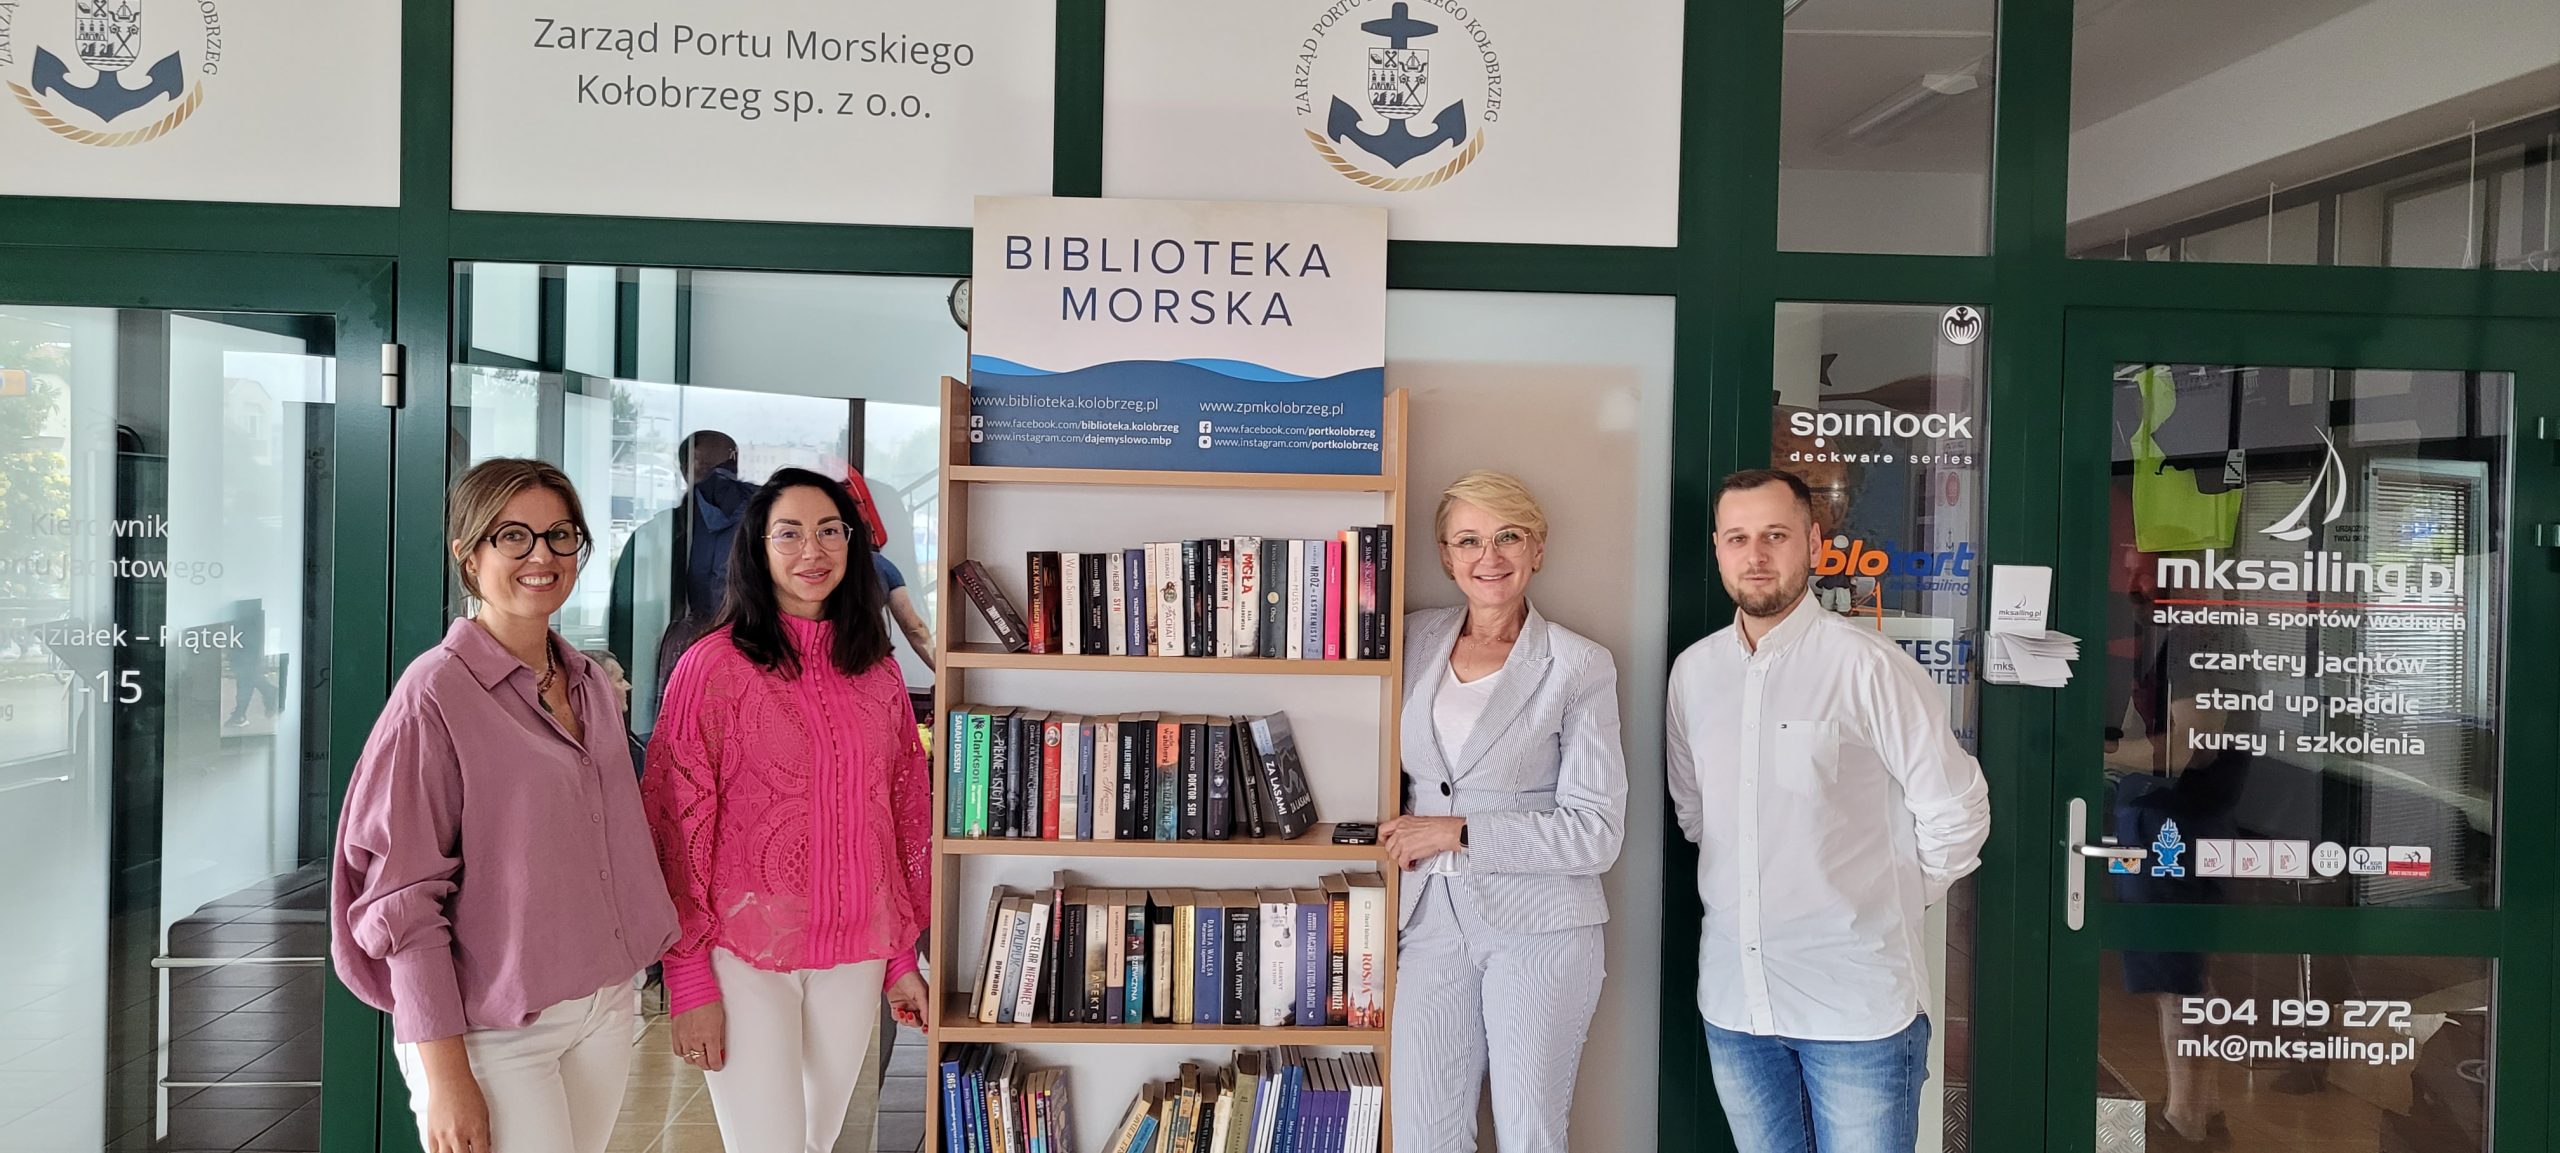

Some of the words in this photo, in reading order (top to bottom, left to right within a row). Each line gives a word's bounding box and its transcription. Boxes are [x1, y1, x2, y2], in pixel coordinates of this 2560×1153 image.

[199, 0, 222, 76] OBRZEG
[533, 18, 659, 60] Zarząd
[672, 24, 772, 58] Portu
[786, 30, 975, 74] Morskiego
[1294, 38, 1318, 116] ZARZĄD
[1465, 19, 1502, 123] KOŁOBRZEG
[577, 74, 761, 120] Kołobrzeg
[773, 89, 824, 122] sp.
[837, 92, 854, 115] z
[866, 92, 931, 118] o.o.
[1005, 235, 1332, 279] BIBLIOTEKA
[1061, 287, 1294, 327] MORSKA
[971, 394, 1159, 413] www.biblioteka.kolobrzeg.pl
[1199, 399, 1344, 417] www.zpmkolobrzeg.pl
[986, 416, 1180, 433] www.facebook.com/biblioteka.kolobrzeg
[1214, 423, 1376, 439] www.facebook.com/portkolobrzeg
[1790, 410, 1973, 448] spinlock
[985, 431, 1172, 447] www.instagram.com/dajemyslowo.mbp
[1214, 437, 1379, 452] www.instagram.com/portkolobrzeg
[1790, 452, 1893, 464] deckware
[1910, 453, 1973, 465] series
[31, 512, 169, 538] Kierownik
[1241, 553, 1255, 594] MGŁA
[1310, 565, 1319, 587] MRÓZ
[2157, 548, 2465, 604] mksailing.pl
[1291, 585, 1299, 612] MUSSO
[2153, 606, 2259, 626] akademia
[2268, 610, 2360, 631] sportów
[2369, 614, 2466, 633] wodnych
[160, 626, 244, 654] Piątek
[1895, 640, 1971, 666] TEST
[2189, 649, 2306, 677] czartery
[2315, 651, 2427, 677] jachtów
[1930, 669, 1970, 685] TER
[2195, 689, 2274, 711] stand
[2286, 694, 2319, 717] up
[2330, 695, 2420, 718] paddle
[2188, 728, 2267, 755] kursy
[2279, 730, 2285, 751] i
[2296, 733, 2425, 755] szkolenia
[953, 744, 962, 772] DESSEN
[972, 731, 983, 784] Clarkson
[1265, 761, 1276, 775] ZA
[1124, 763, 1132, 780] HORST
[1188, 774, 1196, 800] DOKTOR
[1269, 775, 1288, 816] LASAMI
[1188, 803, 1196, 816] SEN
[2320, 849, 2339, 857] SUP
[1334, 901, 1344, 927] NELSON
[1027, 936, 1041, 964] STELAR
[1132, 940, 1140, 949] TA
[1234, 951, 1242, 971] RĘKA
[1333, 955, 1343, 975] ZŁOTE
[1361, 953, 1373, 994] ROSJA
[991, 960, 1004, 996] porwanie
[1131, 956, 1139, 1001] DZIEWCZYNA
[1234, 974, 1242, 1000] FATIMY
[1090, 974, 1099, 1010] AFEKT
[2182, 998, 2258, 1025] 504
[2272, 1000, 2330, 1027] 199
[2343, 1001, 2412, 1028] 272
[2177, 1034, 2415, 1065] mk@mksailing.pl
[946, 1072, 956, 1090] 365
